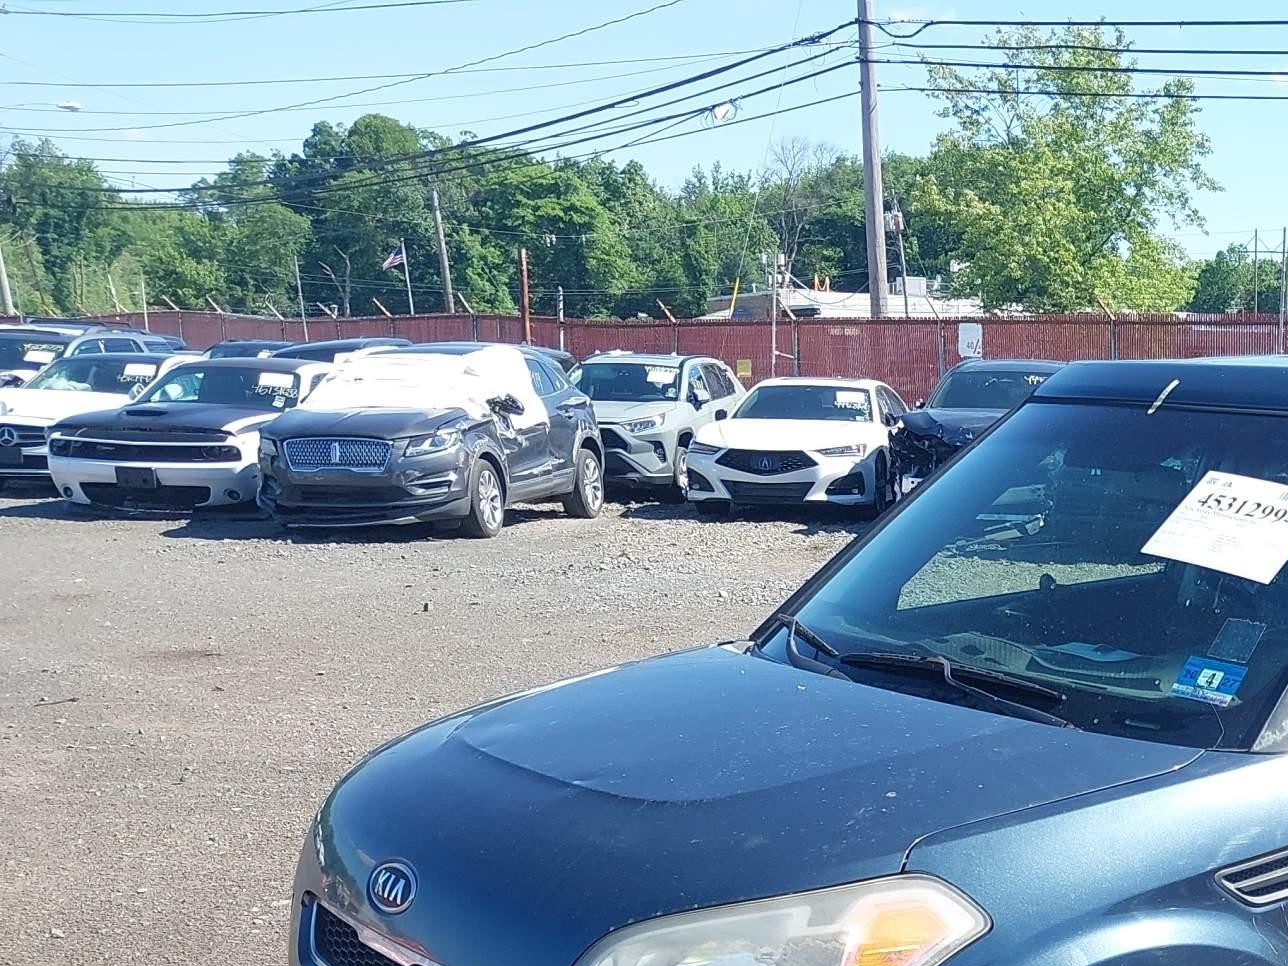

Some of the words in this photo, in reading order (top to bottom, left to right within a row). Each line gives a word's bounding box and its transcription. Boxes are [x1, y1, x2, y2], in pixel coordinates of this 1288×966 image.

[1182, 668, 1198, 680] 20
[1205, 672, 1217, 687] 4
[1221, 677, 1239, 689] 27
[374, 869, 406, 905] KIA
